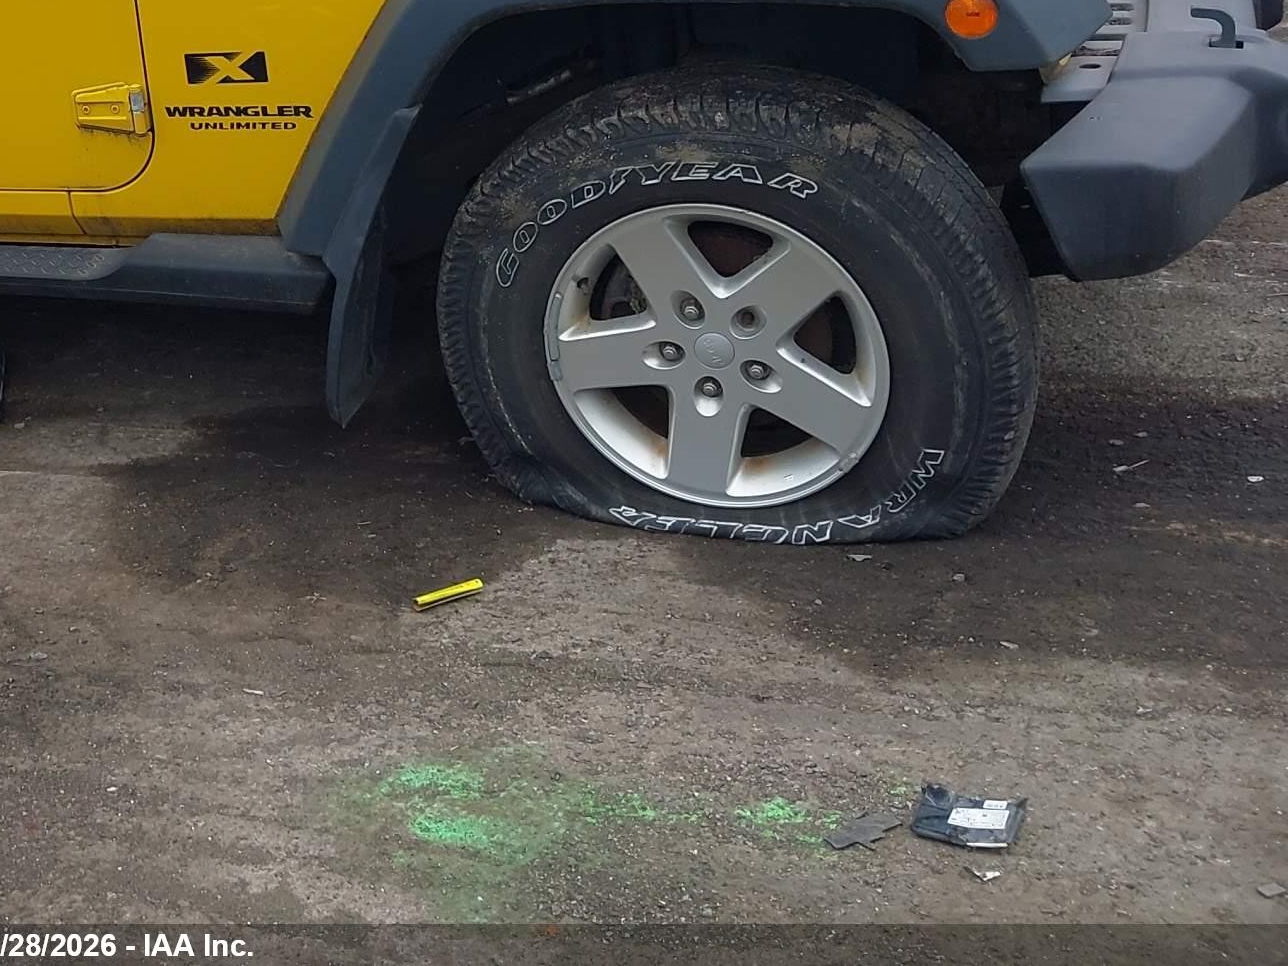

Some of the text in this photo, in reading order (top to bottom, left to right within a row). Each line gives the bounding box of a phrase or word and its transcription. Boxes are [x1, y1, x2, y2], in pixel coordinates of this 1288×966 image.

[197, 50, 260, 85] X
[164, 105, 314, 119] WRANGLER
[189, 121, 298, 131] UNLIMITED
[496, 161, 819, 288] GOODYEAR
[608, 448, 945, 546] WRANGLER
